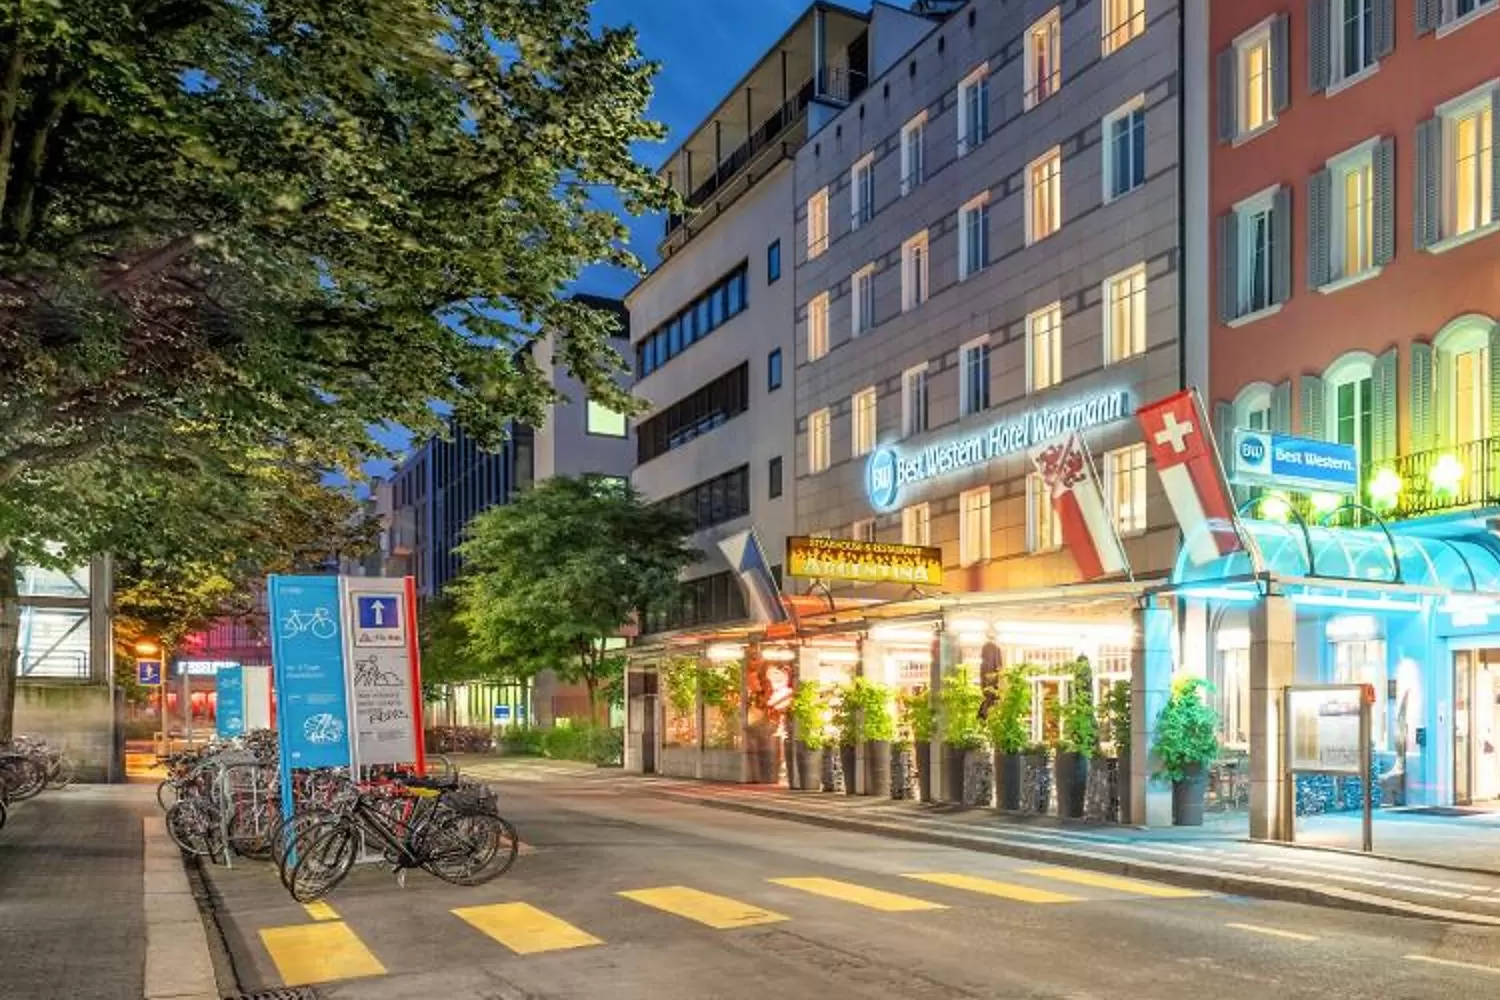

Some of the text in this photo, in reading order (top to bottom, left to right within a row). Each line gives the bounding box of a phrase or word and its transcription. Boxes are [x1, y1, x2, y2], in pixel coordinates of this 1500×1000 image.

[896, 455, 926, 487] Best
[926, 443, 983, 476] Western
[987, 414, 1030, 457] Hotel
[1031, 391, 1122, 444] Wartmann
[1275, 447, 1303, 465] Best
